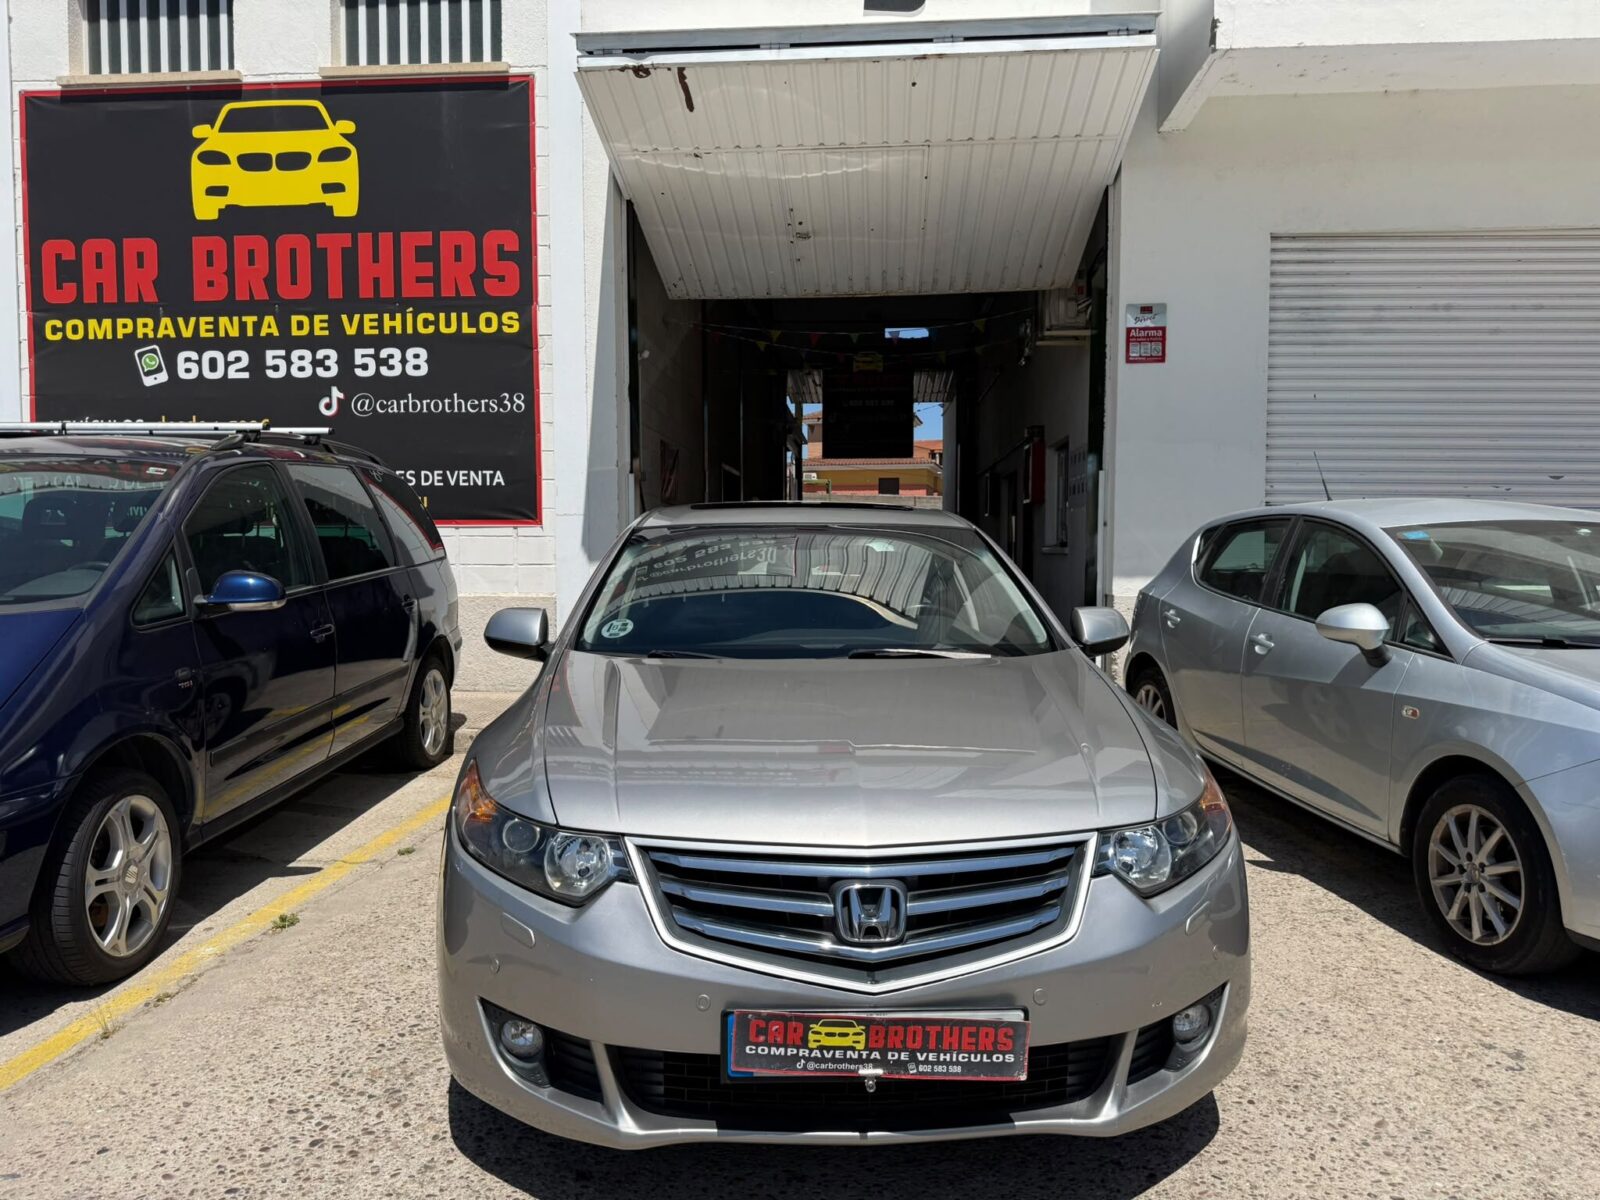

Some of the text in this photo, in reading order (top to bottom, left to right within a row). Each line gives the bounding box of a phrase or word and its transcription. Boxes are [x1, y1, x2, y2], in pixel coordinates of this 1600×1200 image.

[41, 229, 521, 304] CAR BROTHERS
[45, 307, 520, 341] COMPRAVENTA DE VEHÍCULOS
[1130, 329, 1162, 337] Alarma
[176, 347, 429, 380] 602 583 538
[351, 392, 525, 417] @carbrothers38
[421, 470, 444, 486] DE
[446, 470, 505, 487] VENTA
[749, 1019, 1015, 1051] CAR BROTHERS
[745, 1045, 1015, 1063] COMPRAVENTA DE VEHÍCULOS
[948, 1065, 962, 1073] 538
